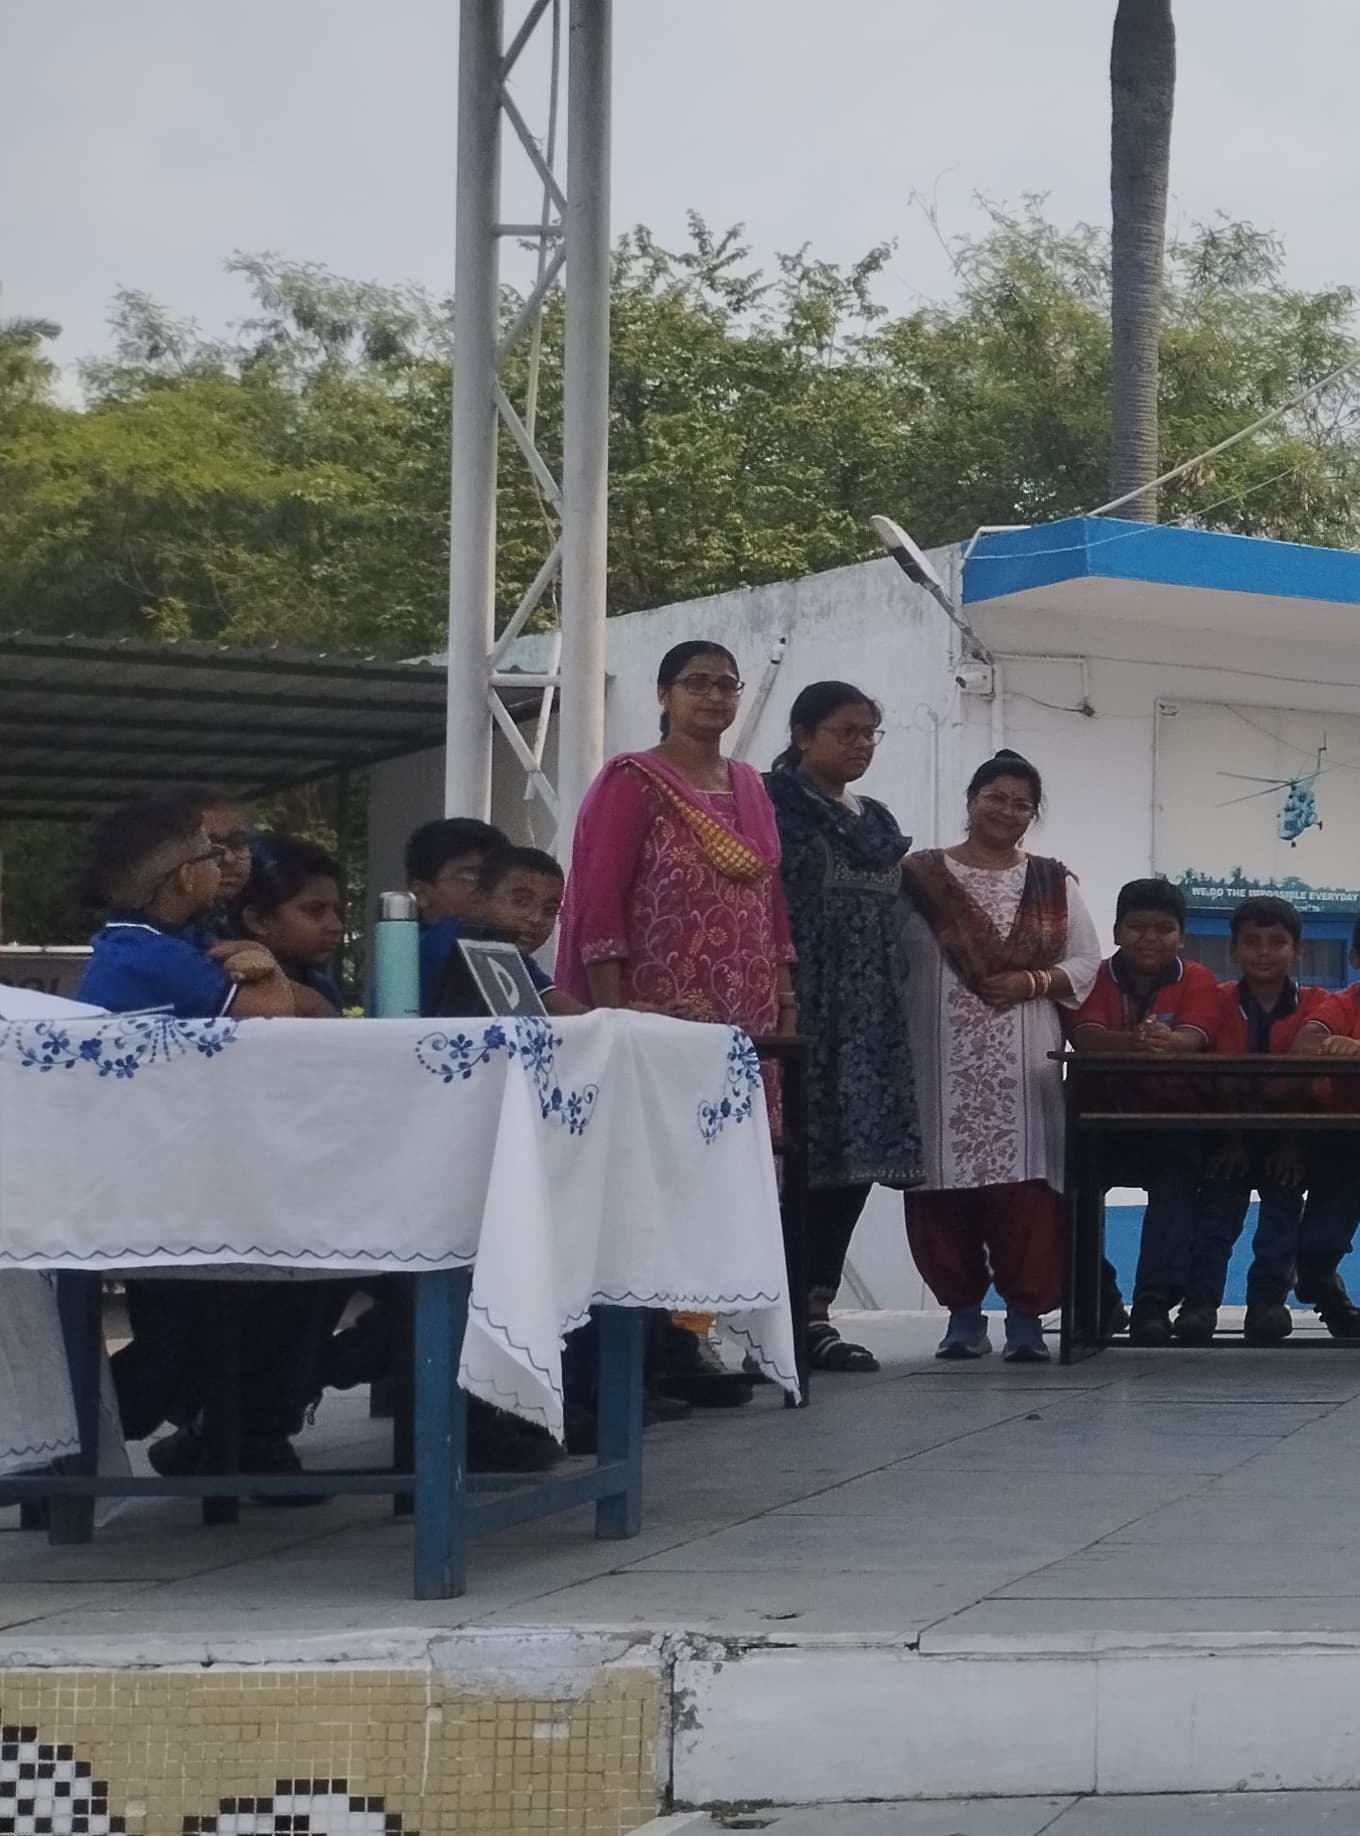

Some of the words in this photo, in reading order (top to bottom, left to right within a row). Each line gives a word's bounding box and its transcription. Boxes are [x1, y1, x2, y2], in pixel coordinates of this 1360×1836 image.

[1227, 888, 1246, 898] THE
[1309, 892, 1360, 901] EVERYDAY
[487, 957, 520, 1010] D
